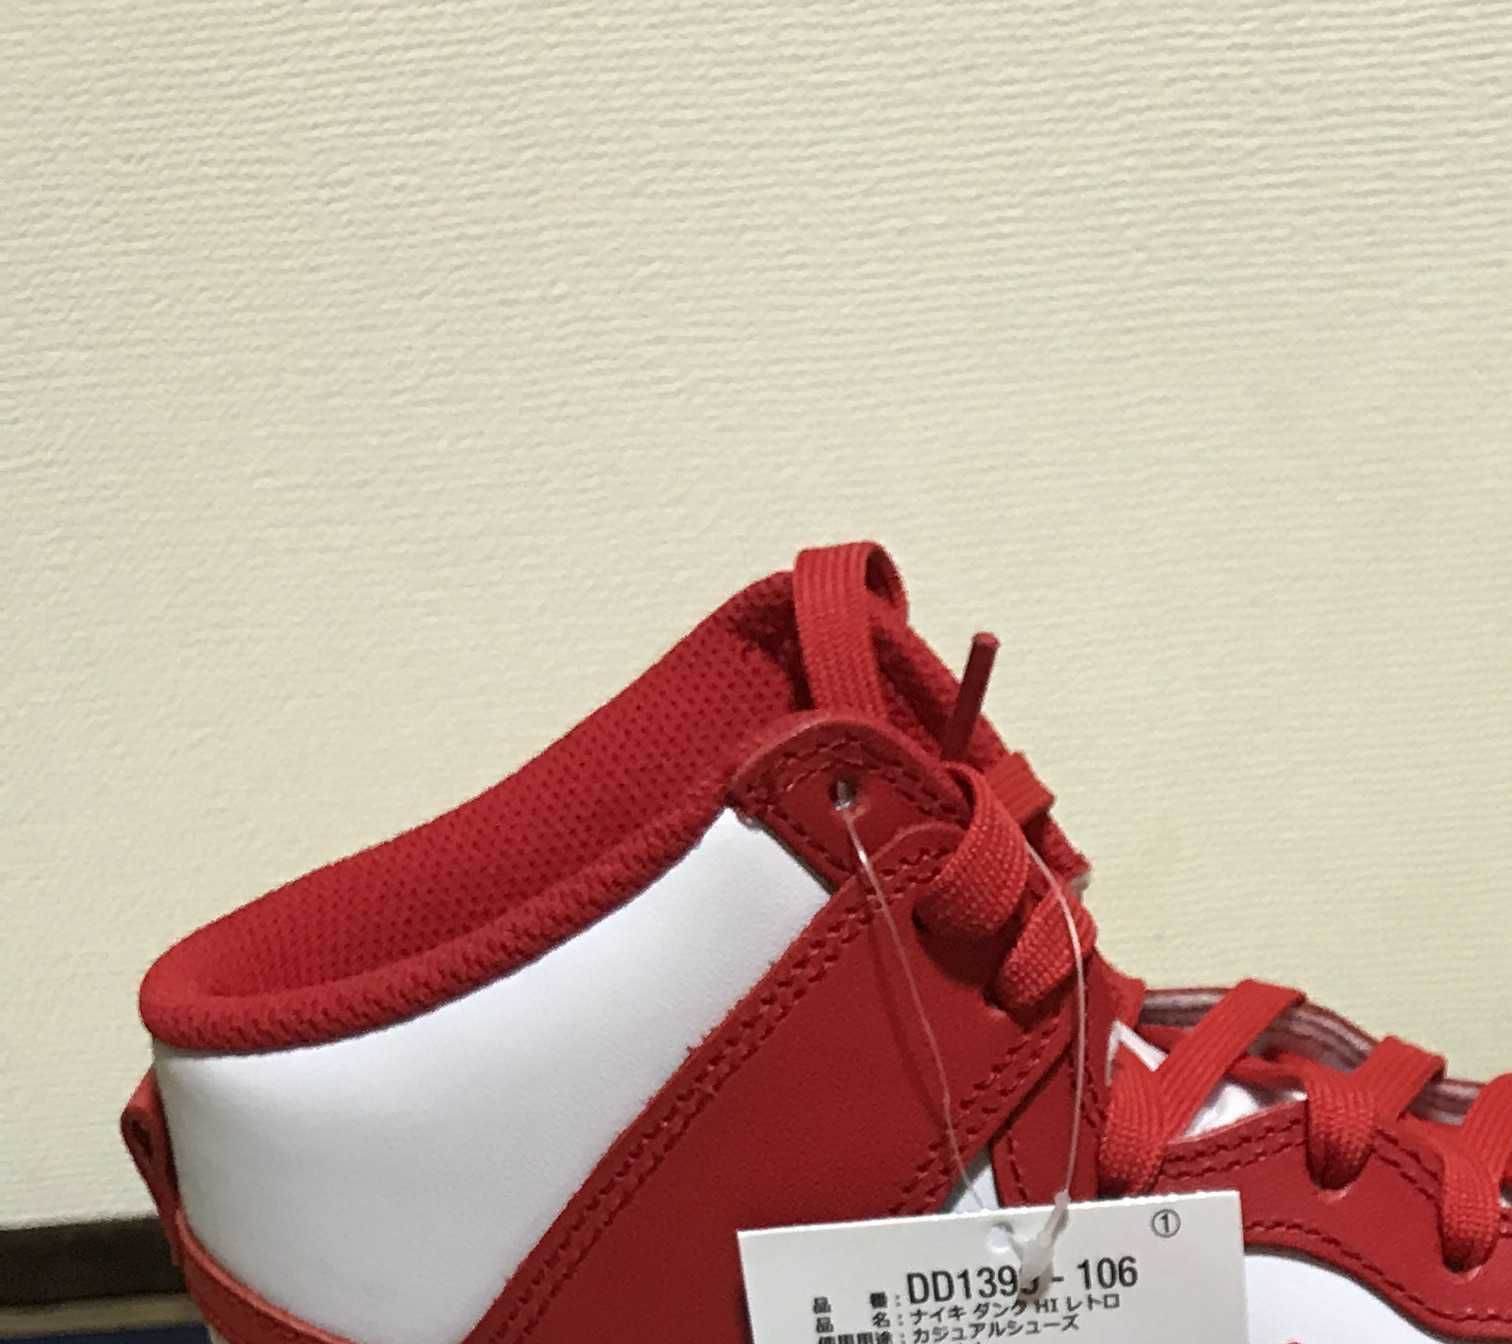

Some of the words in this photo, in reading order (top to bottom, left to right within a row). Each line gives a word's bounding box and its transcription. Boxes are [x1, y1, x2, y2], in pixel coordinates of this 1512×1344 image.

[1077, 1256, 1138, 1290] 106
[1066, 1293, 1120, 1312] レトロ
